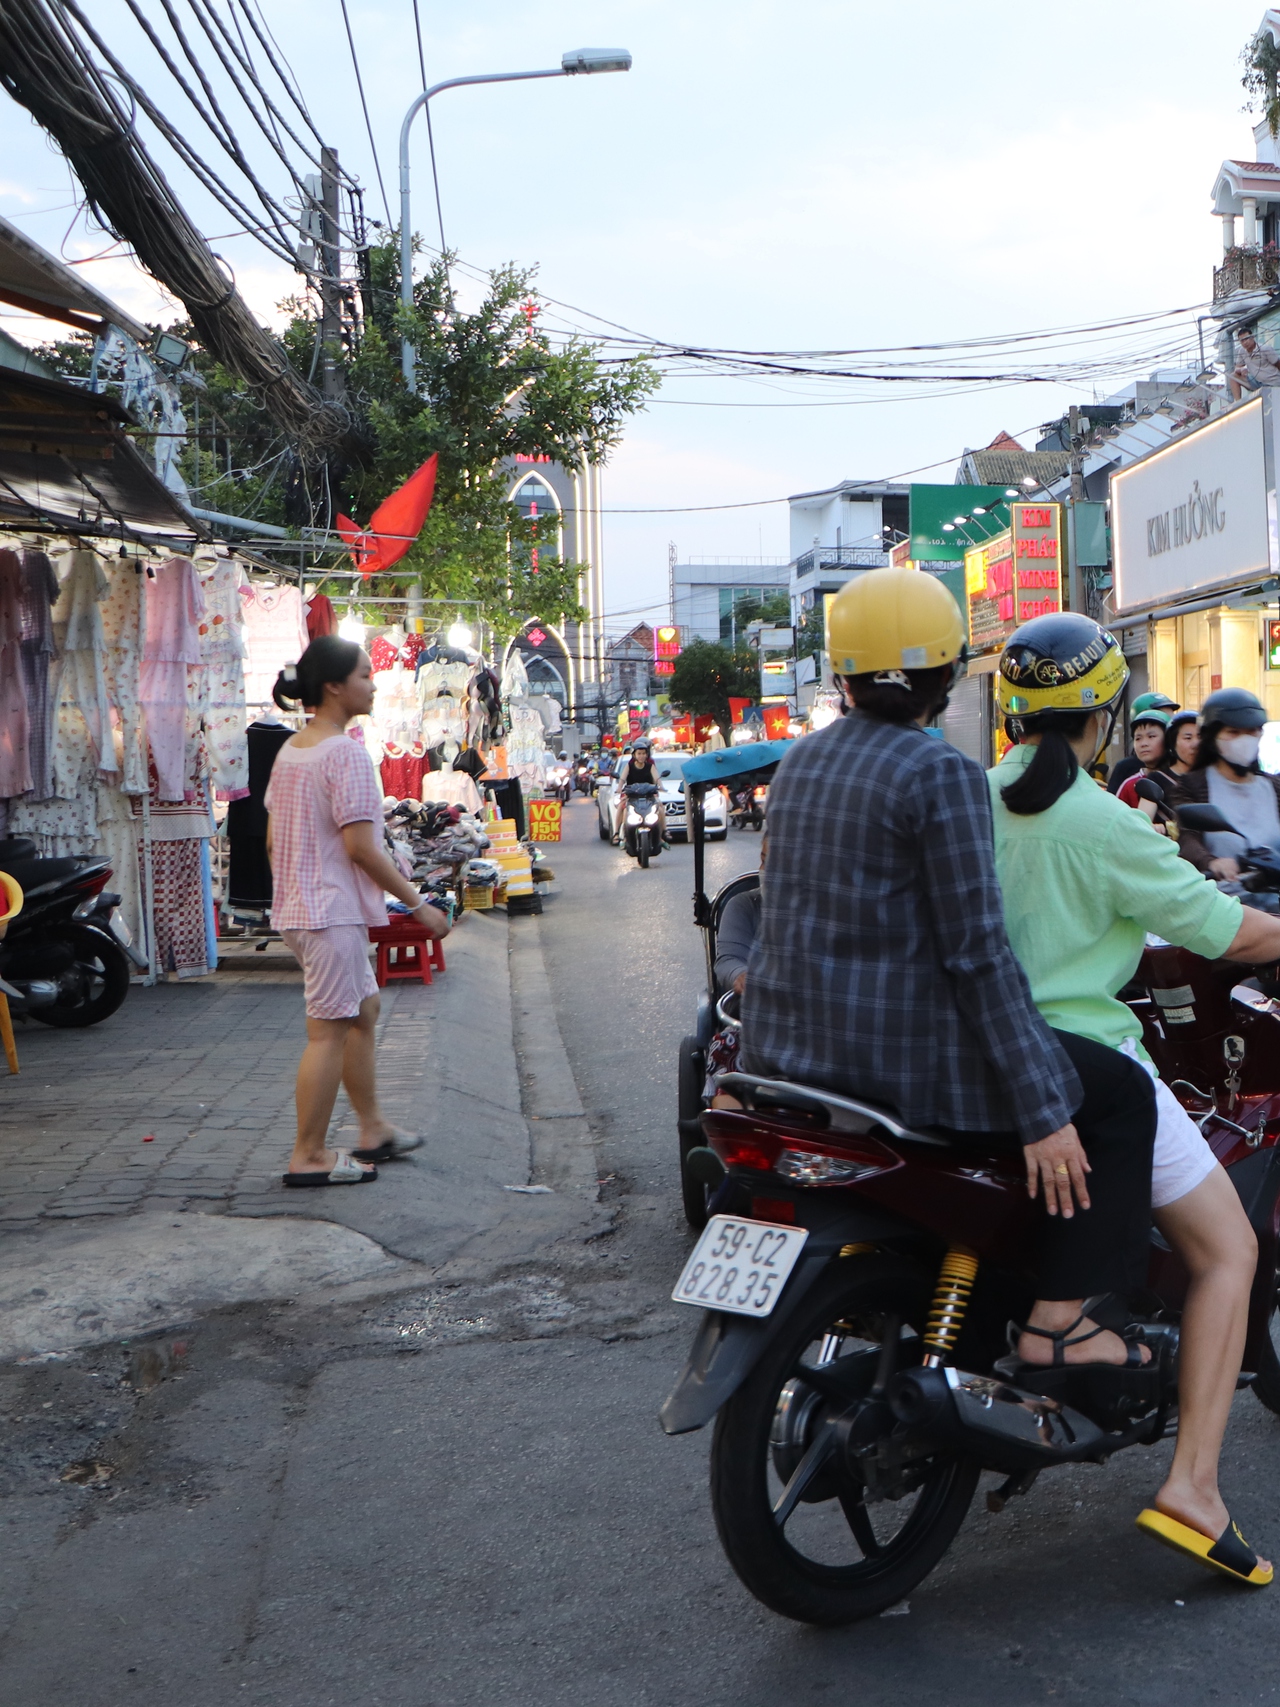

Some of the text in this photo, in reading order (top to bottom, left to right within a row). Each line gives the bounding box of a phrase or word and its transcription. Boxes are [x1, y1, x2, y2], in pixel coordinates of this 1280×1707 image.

[1022, 509, 1051, 527] KIM
[1147, 480, 1226, 557] KIM HƯỞNG
[1016, 534, 1058, 558] PHÁT
[1018, 570, 1058, 589] MINH
[1020, 596, 1058, 620] KHÔI
[531, 821, 560, 834] 15K
[711, 1223, 788, 1268] 59-C2
[683, 1261, 779, 1308] 828.35
